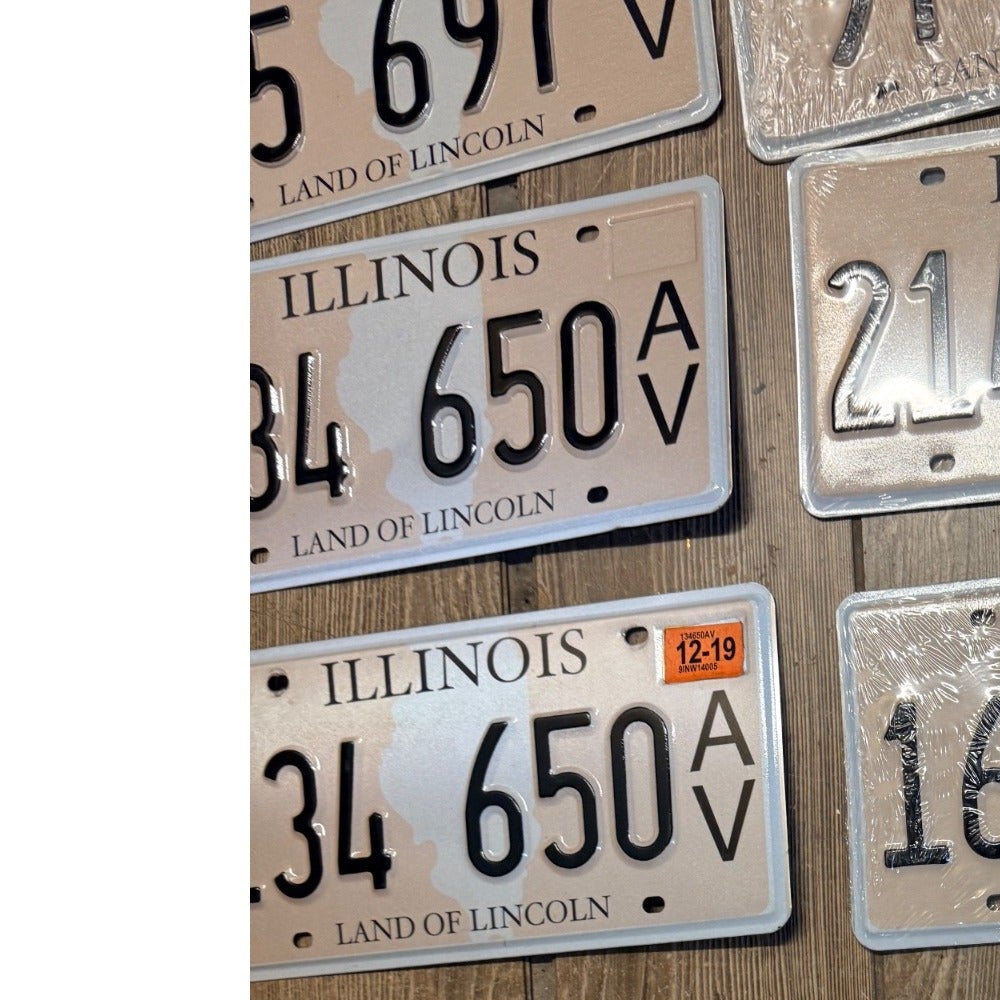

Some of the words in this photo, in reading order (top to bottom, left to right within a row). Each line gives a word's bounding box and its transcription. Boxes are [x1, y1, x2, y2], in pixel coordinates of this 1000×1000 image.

[278, 168, 358, 207] LAND
[365, 153, 403, 183] OF
[410, 114, 545, 171] LINCOLN
[278, 229, 541, 320] ILLINOIS
[420, 300, 620, 479] 650
[290, 524, 370, 559] LAND
[377, 513, 415, 543] OF
[420, 489, 557, 536] LINCOLN
[321, 628, 589, 706] ILLINOIS
[676, 636, 736, 665] 12-19
[250, 740, 392, 899] 34
[465, 706, 674, 877] 650
[335, 915, 416, 946] LAND
[423, 909, 462, 936] OF
[469, 895, 611, 932] LINCOLN
